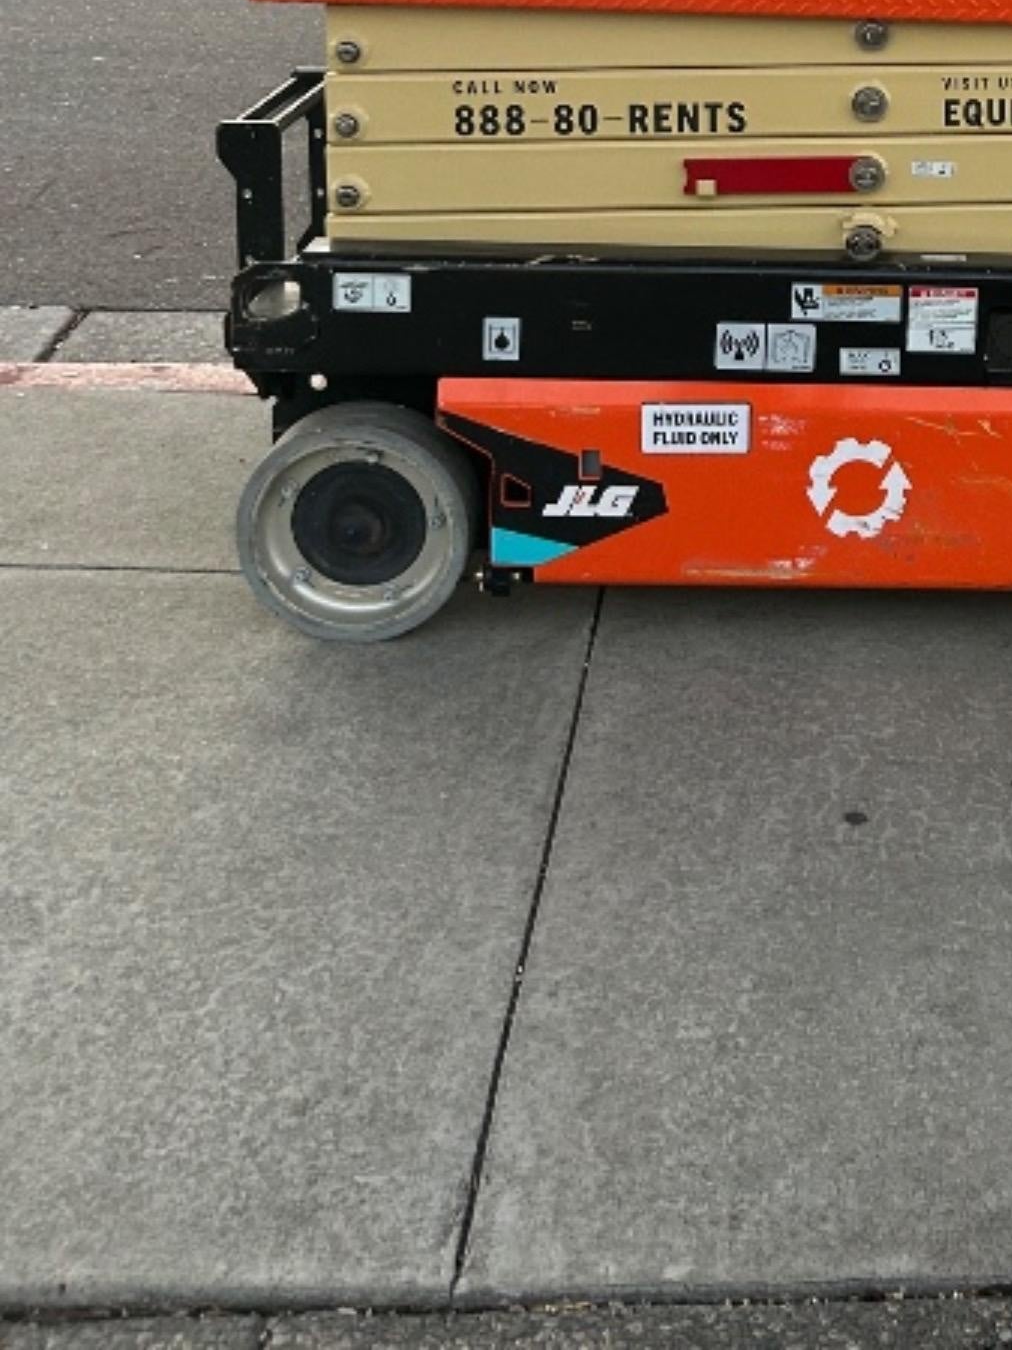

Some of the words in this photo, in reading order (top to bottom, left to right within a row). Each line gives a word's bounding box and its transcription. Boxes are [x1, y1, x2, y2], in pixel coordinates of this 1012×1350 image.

[453, 79, 503, 95] CALL
[514, 79, 558, 95] NOW
[941, 76, 989, 91] VISIT
[454, 101, 747, 136] 888-80-RENTS
[653, 411, 739, 427] HYDRAULIC
[653, 431, 697, 445] FLUID
[701, 431, 739, 445] ONLY
[542, 485, 640, 517] JLG
